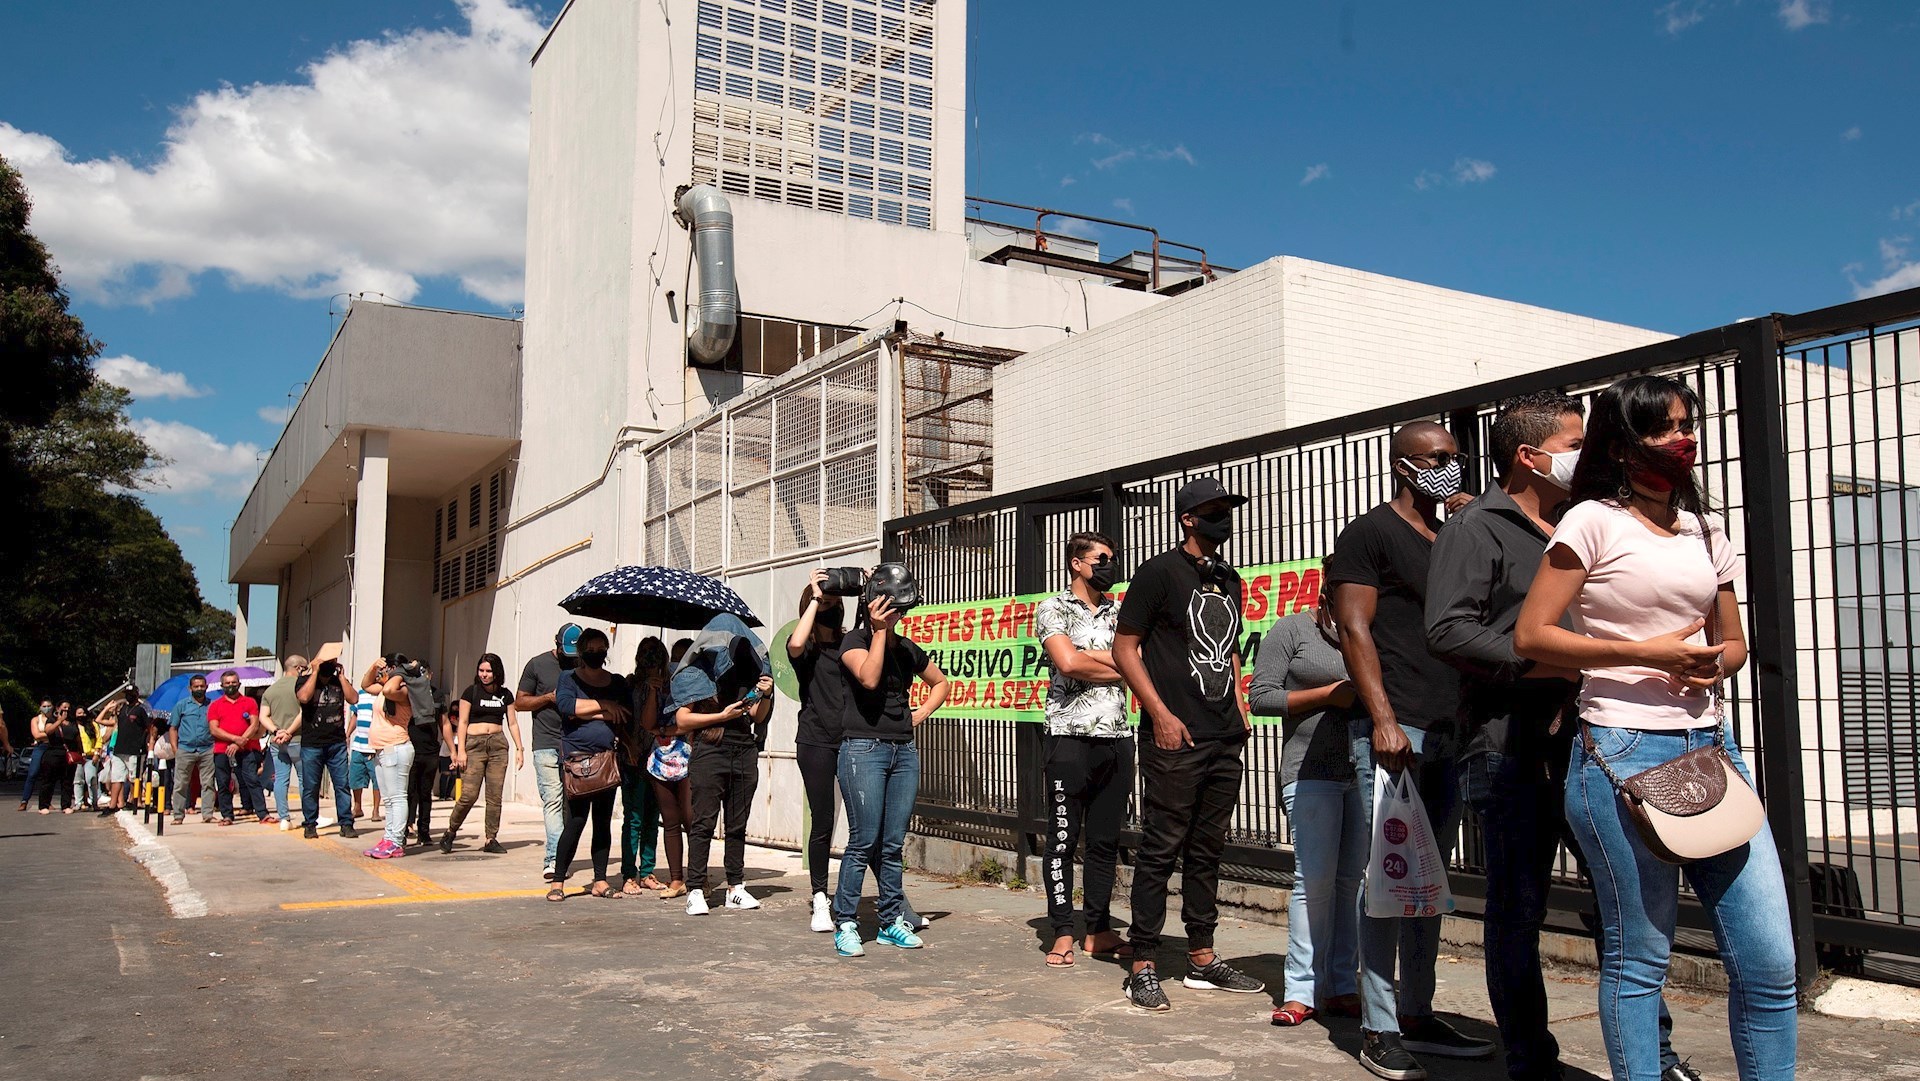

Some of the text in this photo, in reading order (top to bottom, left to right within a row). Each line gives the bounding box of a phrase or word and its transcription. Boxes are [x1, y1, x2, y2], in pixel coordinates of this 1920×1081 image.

[901, 608, 976, 643] TESTES
[980, 598, 1040, 641] RÁPI
[480, 699, 501, 707] PUMA
[981, 681, 996, 709] A
[1386, 859, 1400, 873] 24
